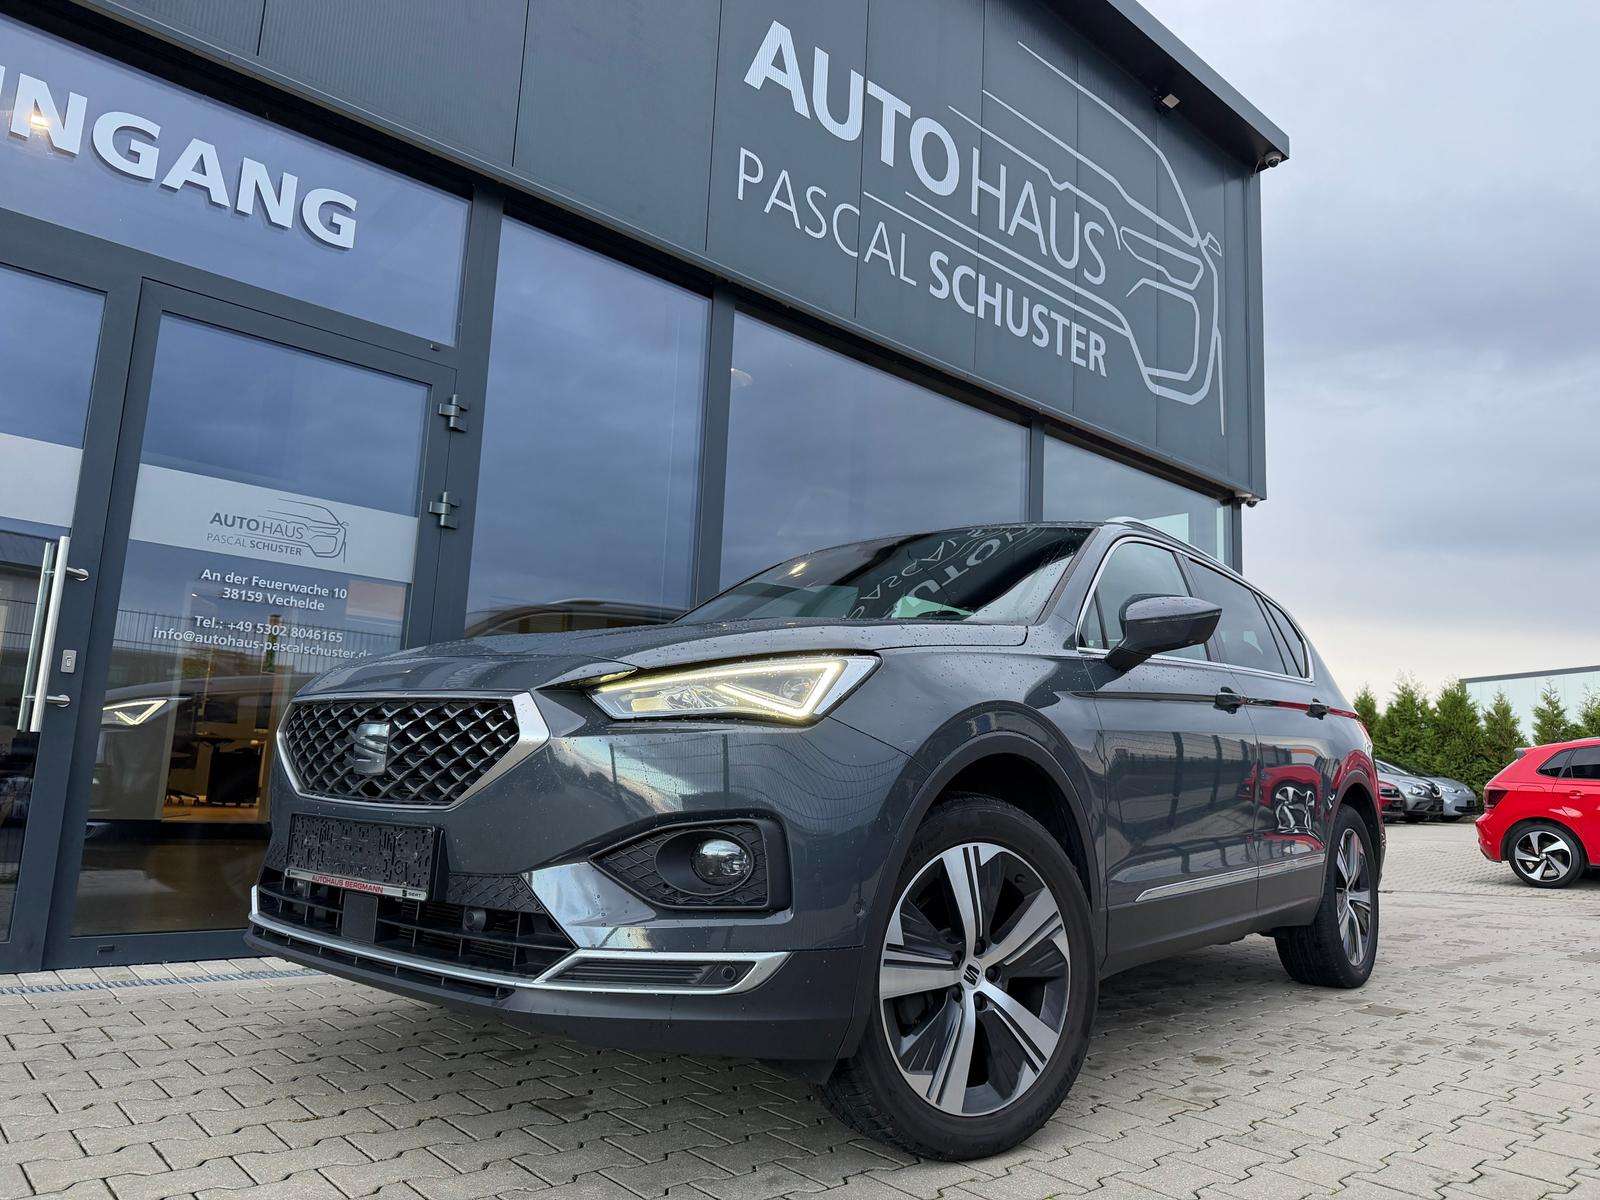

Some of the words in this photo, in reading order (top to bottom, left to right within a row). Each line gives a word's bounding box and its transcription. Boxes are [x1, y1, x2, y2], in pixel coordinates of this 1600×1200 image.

[0, 65, 358, 249] NGANG
[738, 147, 916, 287] PASCAL
[929, 251, 1107, 378] SCHUSTER
[206, 532, 247, 548] PASCAL
[249, 539, 302, 556] SCHUSTER
[201, 569, 221, 581] An
[225, 572, 248, 585] der
[251, 575, 329, 597] Feuerwache
[334, 588, 347, 599] 10
[222, 587, 263, 603] 38159
[267, 593, 325, 611] Vechelde
[153, 626, 373, 659] info@autohaus-pascalschuster.d
[195, 615, 224, 629] Tel.:
[227, 620, 252, 633] +49
[256, 623, 288, 637] 5302
[291, 627, 344, 643] 8046165
[312, 875, 343, 887] AUTOHAUS
[344, 880, 384, 894] BERGMANN
